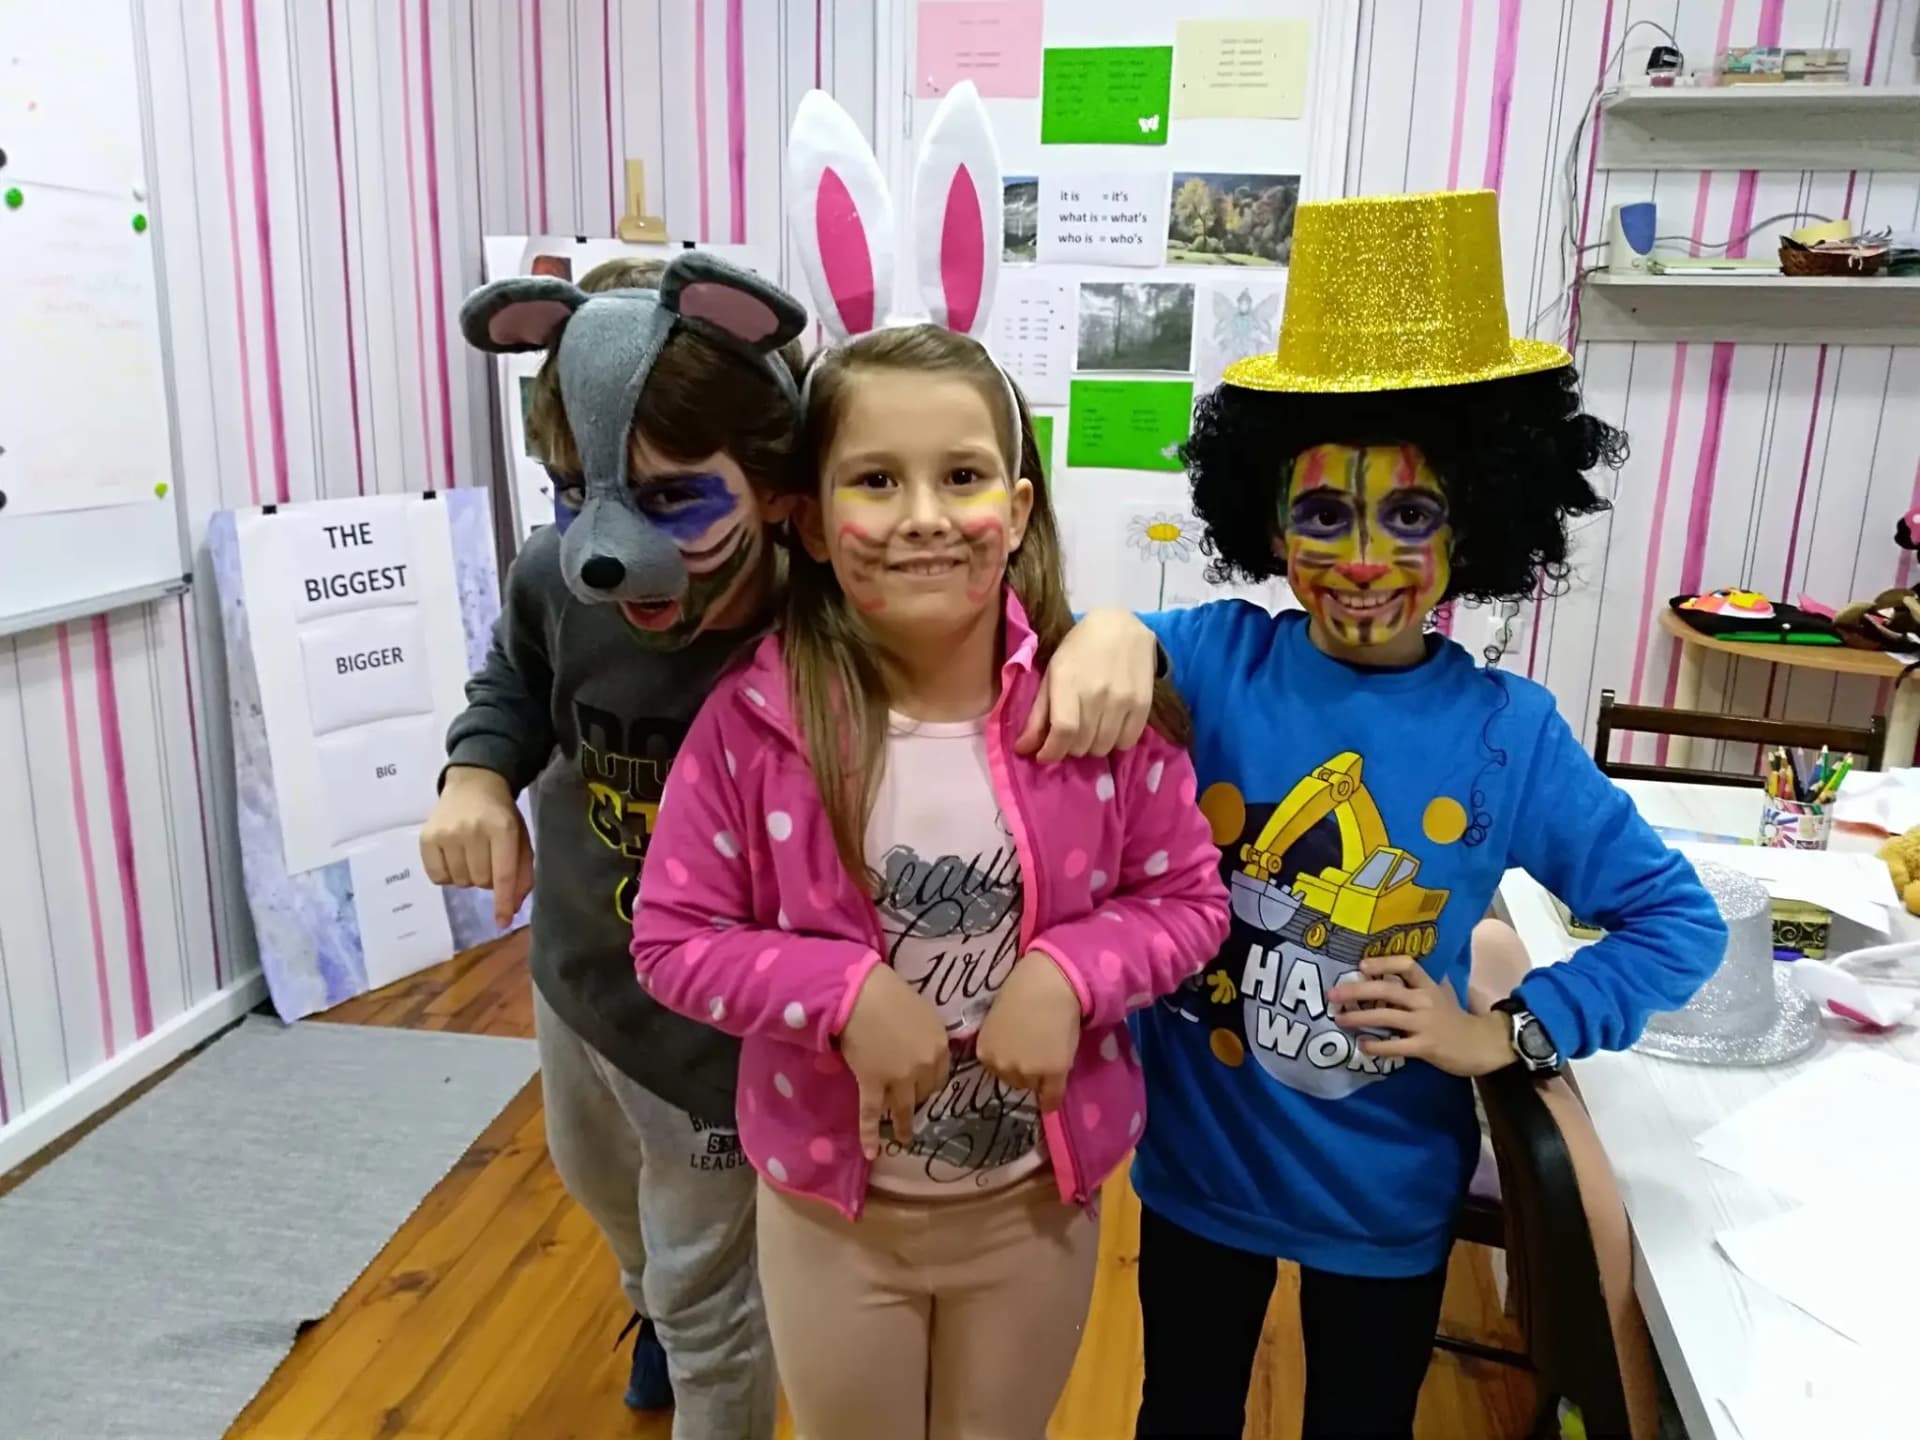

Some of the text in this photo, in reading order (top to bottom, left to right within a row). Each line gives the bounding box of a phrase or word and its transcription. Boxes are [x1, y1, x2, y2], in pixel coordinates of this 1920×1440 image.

[1060, 191, 1069, 201] it
[1071, 191, 1080, 202] is
[1112, 191, 1129, 202] it's
[1059, 212, 1087, 223] what
[1090, 212, 1098, 223] is
[1111, 212, 1148, 223] what's
[1058, 232, 1082, 243] who
[1085, 233, 1093, 244] is
[1110, 233, 1143, 244] who's
[323, 522, 374, 550] THE
[304, 565, 408, 602] BIGGEST
[335, 646, 404, 675] BIGGER
[376, 763, 397, 779] BIG
[385, 867, 411, 885] small
